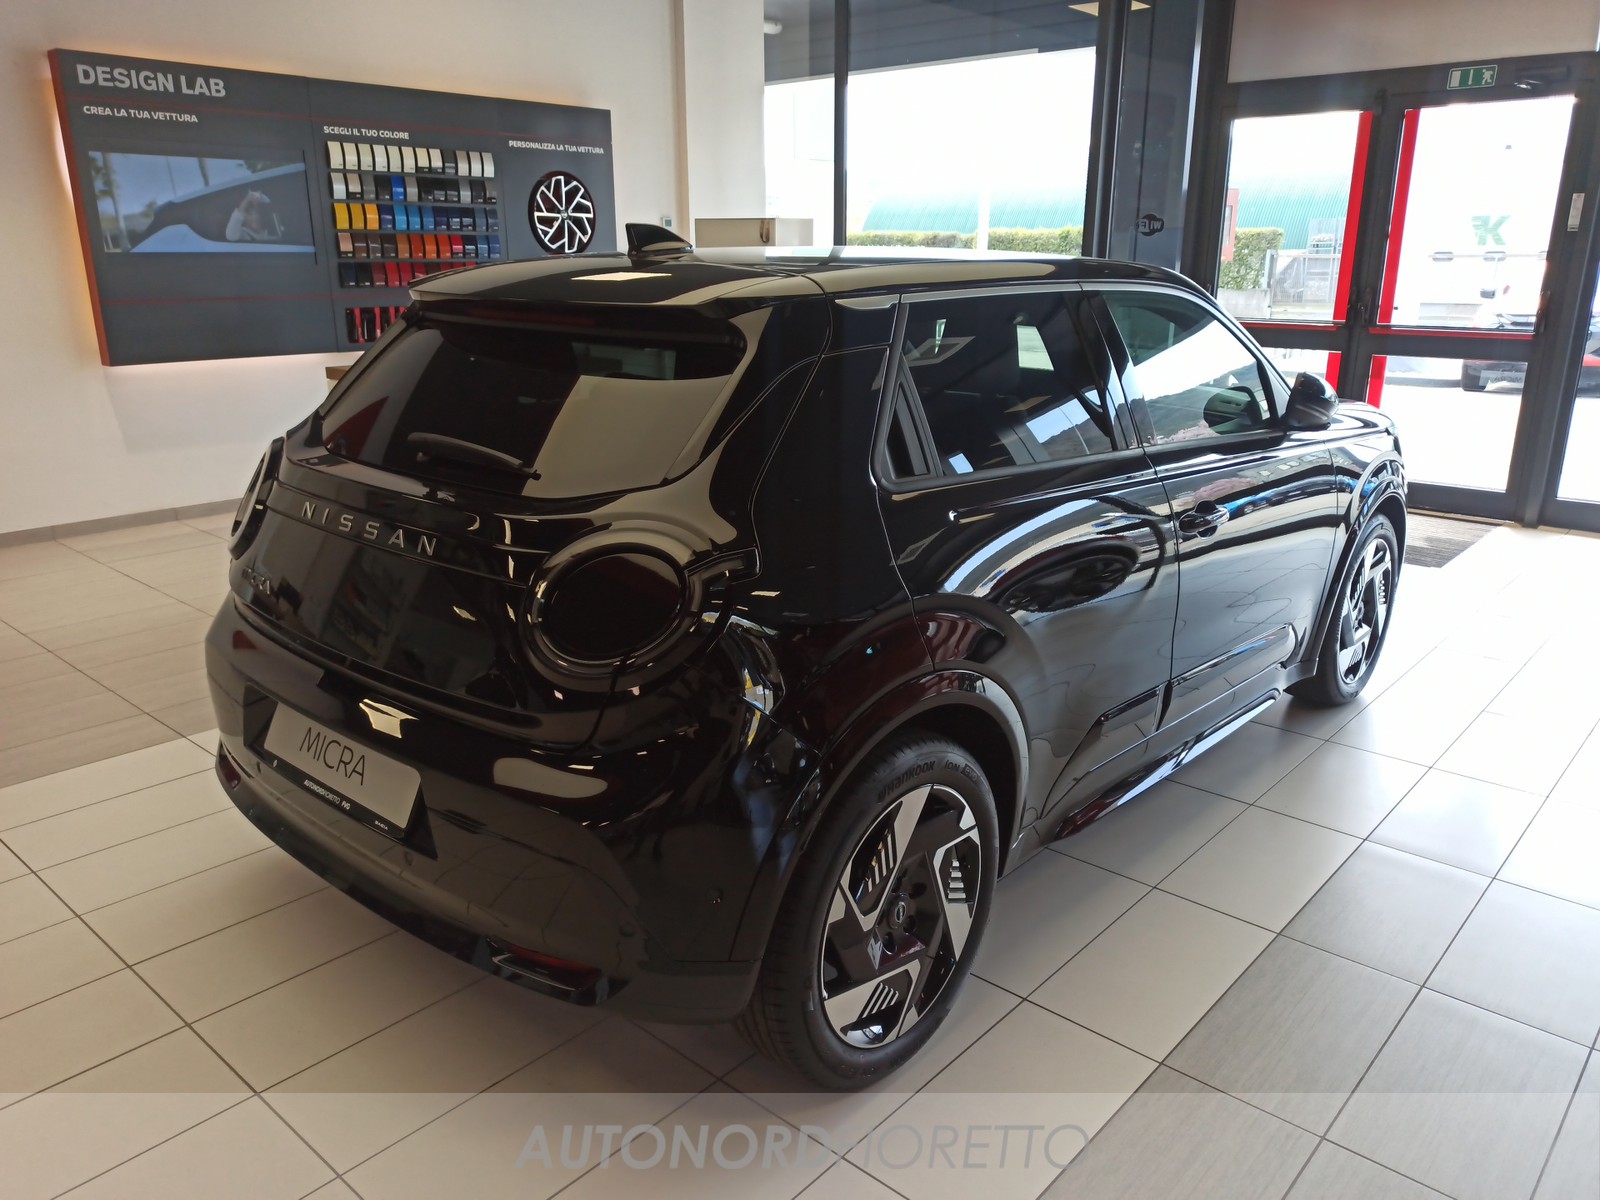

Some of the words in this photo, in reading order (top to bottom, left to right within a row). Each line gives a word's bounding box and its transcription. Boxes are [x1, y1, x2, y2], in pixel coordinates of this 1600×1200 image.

[76, 63, 175, 93] DESIGN
[180, 74, 226, 97] LAB
[83, 105, 112, 116] CREA
[114, 108, 128, 117] LA
[128, 109, 151, 119] TUA
[151, 111, 199, 122] VETTURA
[323, 125, 351, 135] SCEGLI
[353, 128, 360, 136] IL
[361, 128, 378, 137] TUO
[379, 130, 410, 140] COLORE
[508, 140, 556, 151] PERSONALIZZA
[564, 144, 577, 152] TUA
[577, 145, 605, 154] VETTURA
[301, 501, 437, 556] NISSAN
[299, 727, 366, 786] MICRA
